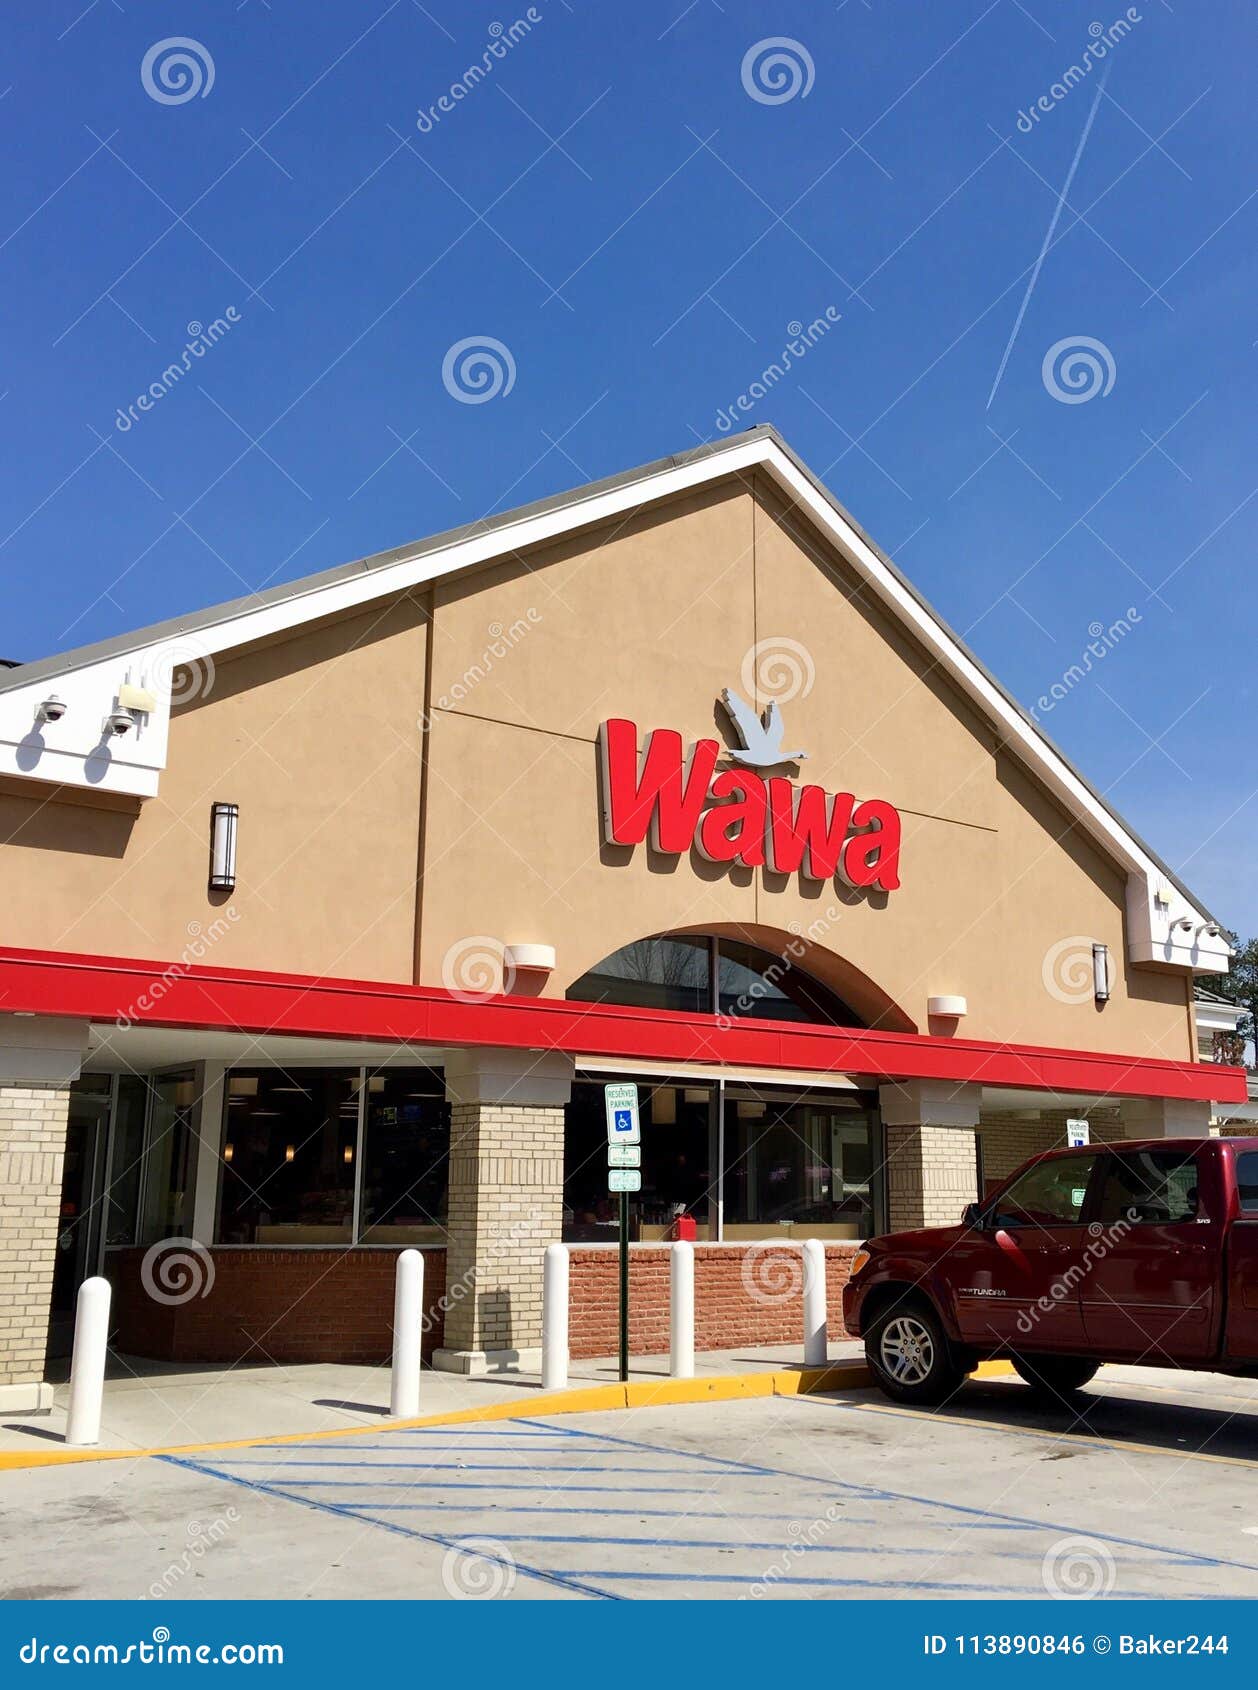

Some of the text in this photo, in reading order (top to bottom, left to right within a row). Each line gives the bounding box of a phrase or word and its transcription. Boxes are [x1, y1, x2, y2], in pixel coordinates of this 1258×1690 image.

[604, 718, 901, 890] Wawa
[607, 1089, 637, 1098] RESERVED
[610, 1100, 635, 1108] PARKING
[972, 1288, 1007, 1297] TUNDRA
